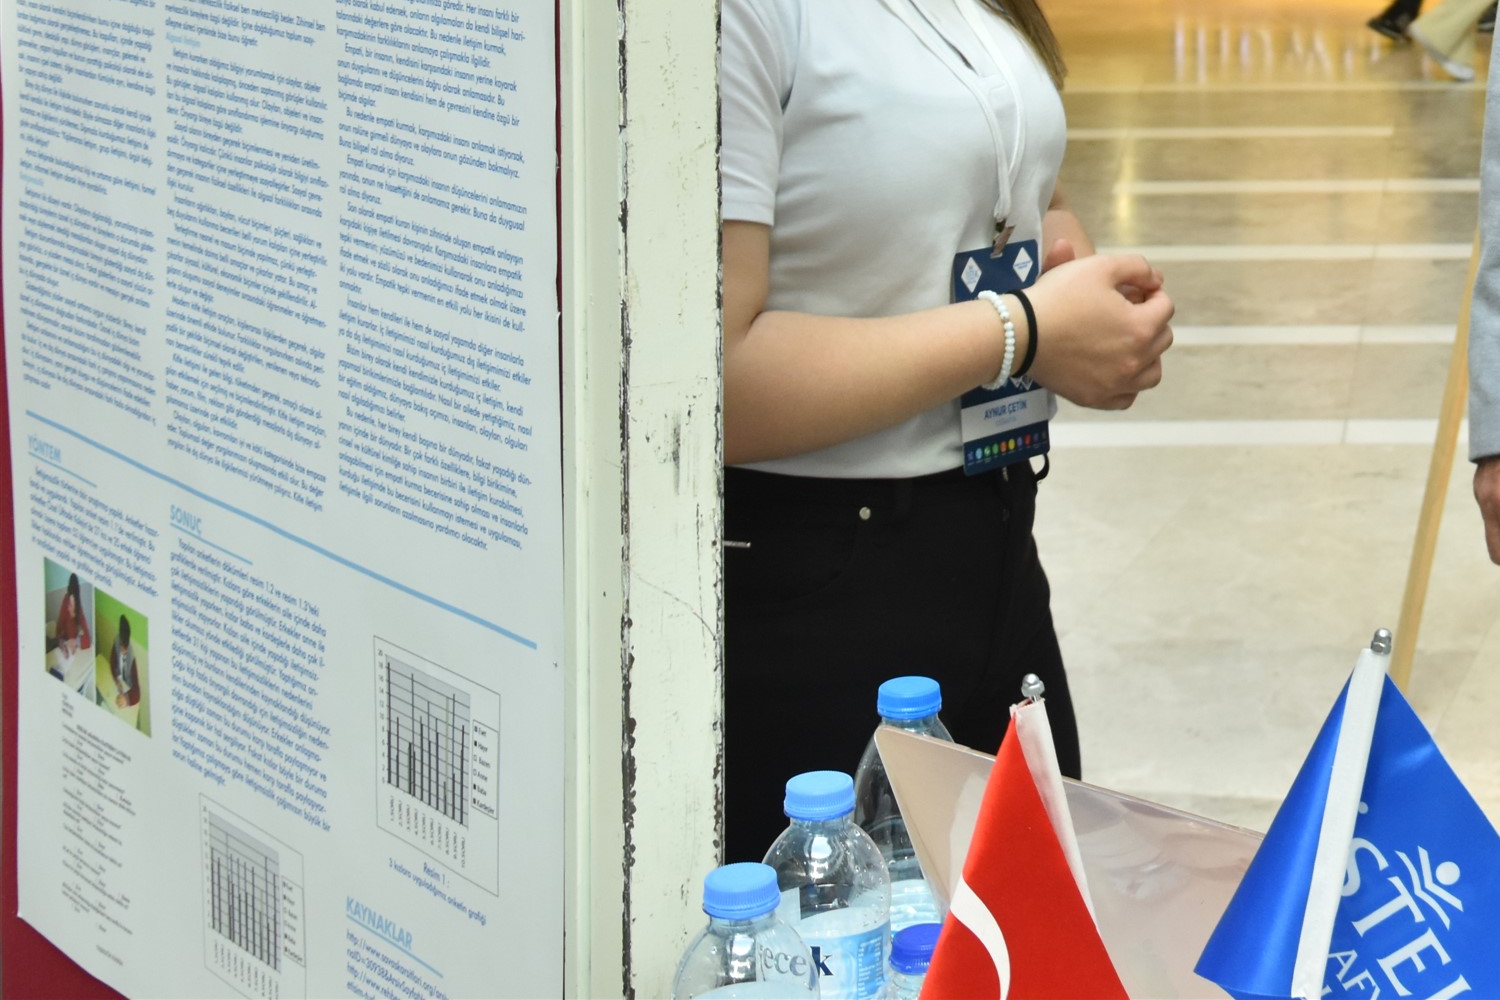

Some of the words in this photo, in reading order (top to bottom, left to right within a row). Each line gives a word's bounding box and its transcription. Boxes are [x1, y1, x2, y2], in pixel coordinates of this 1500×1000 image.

[170, 504, 202, 535] SONUÇ
[346, 896, 412, 949] KAYNAKLAR
[1340, 801, 1472, 1000] STE
